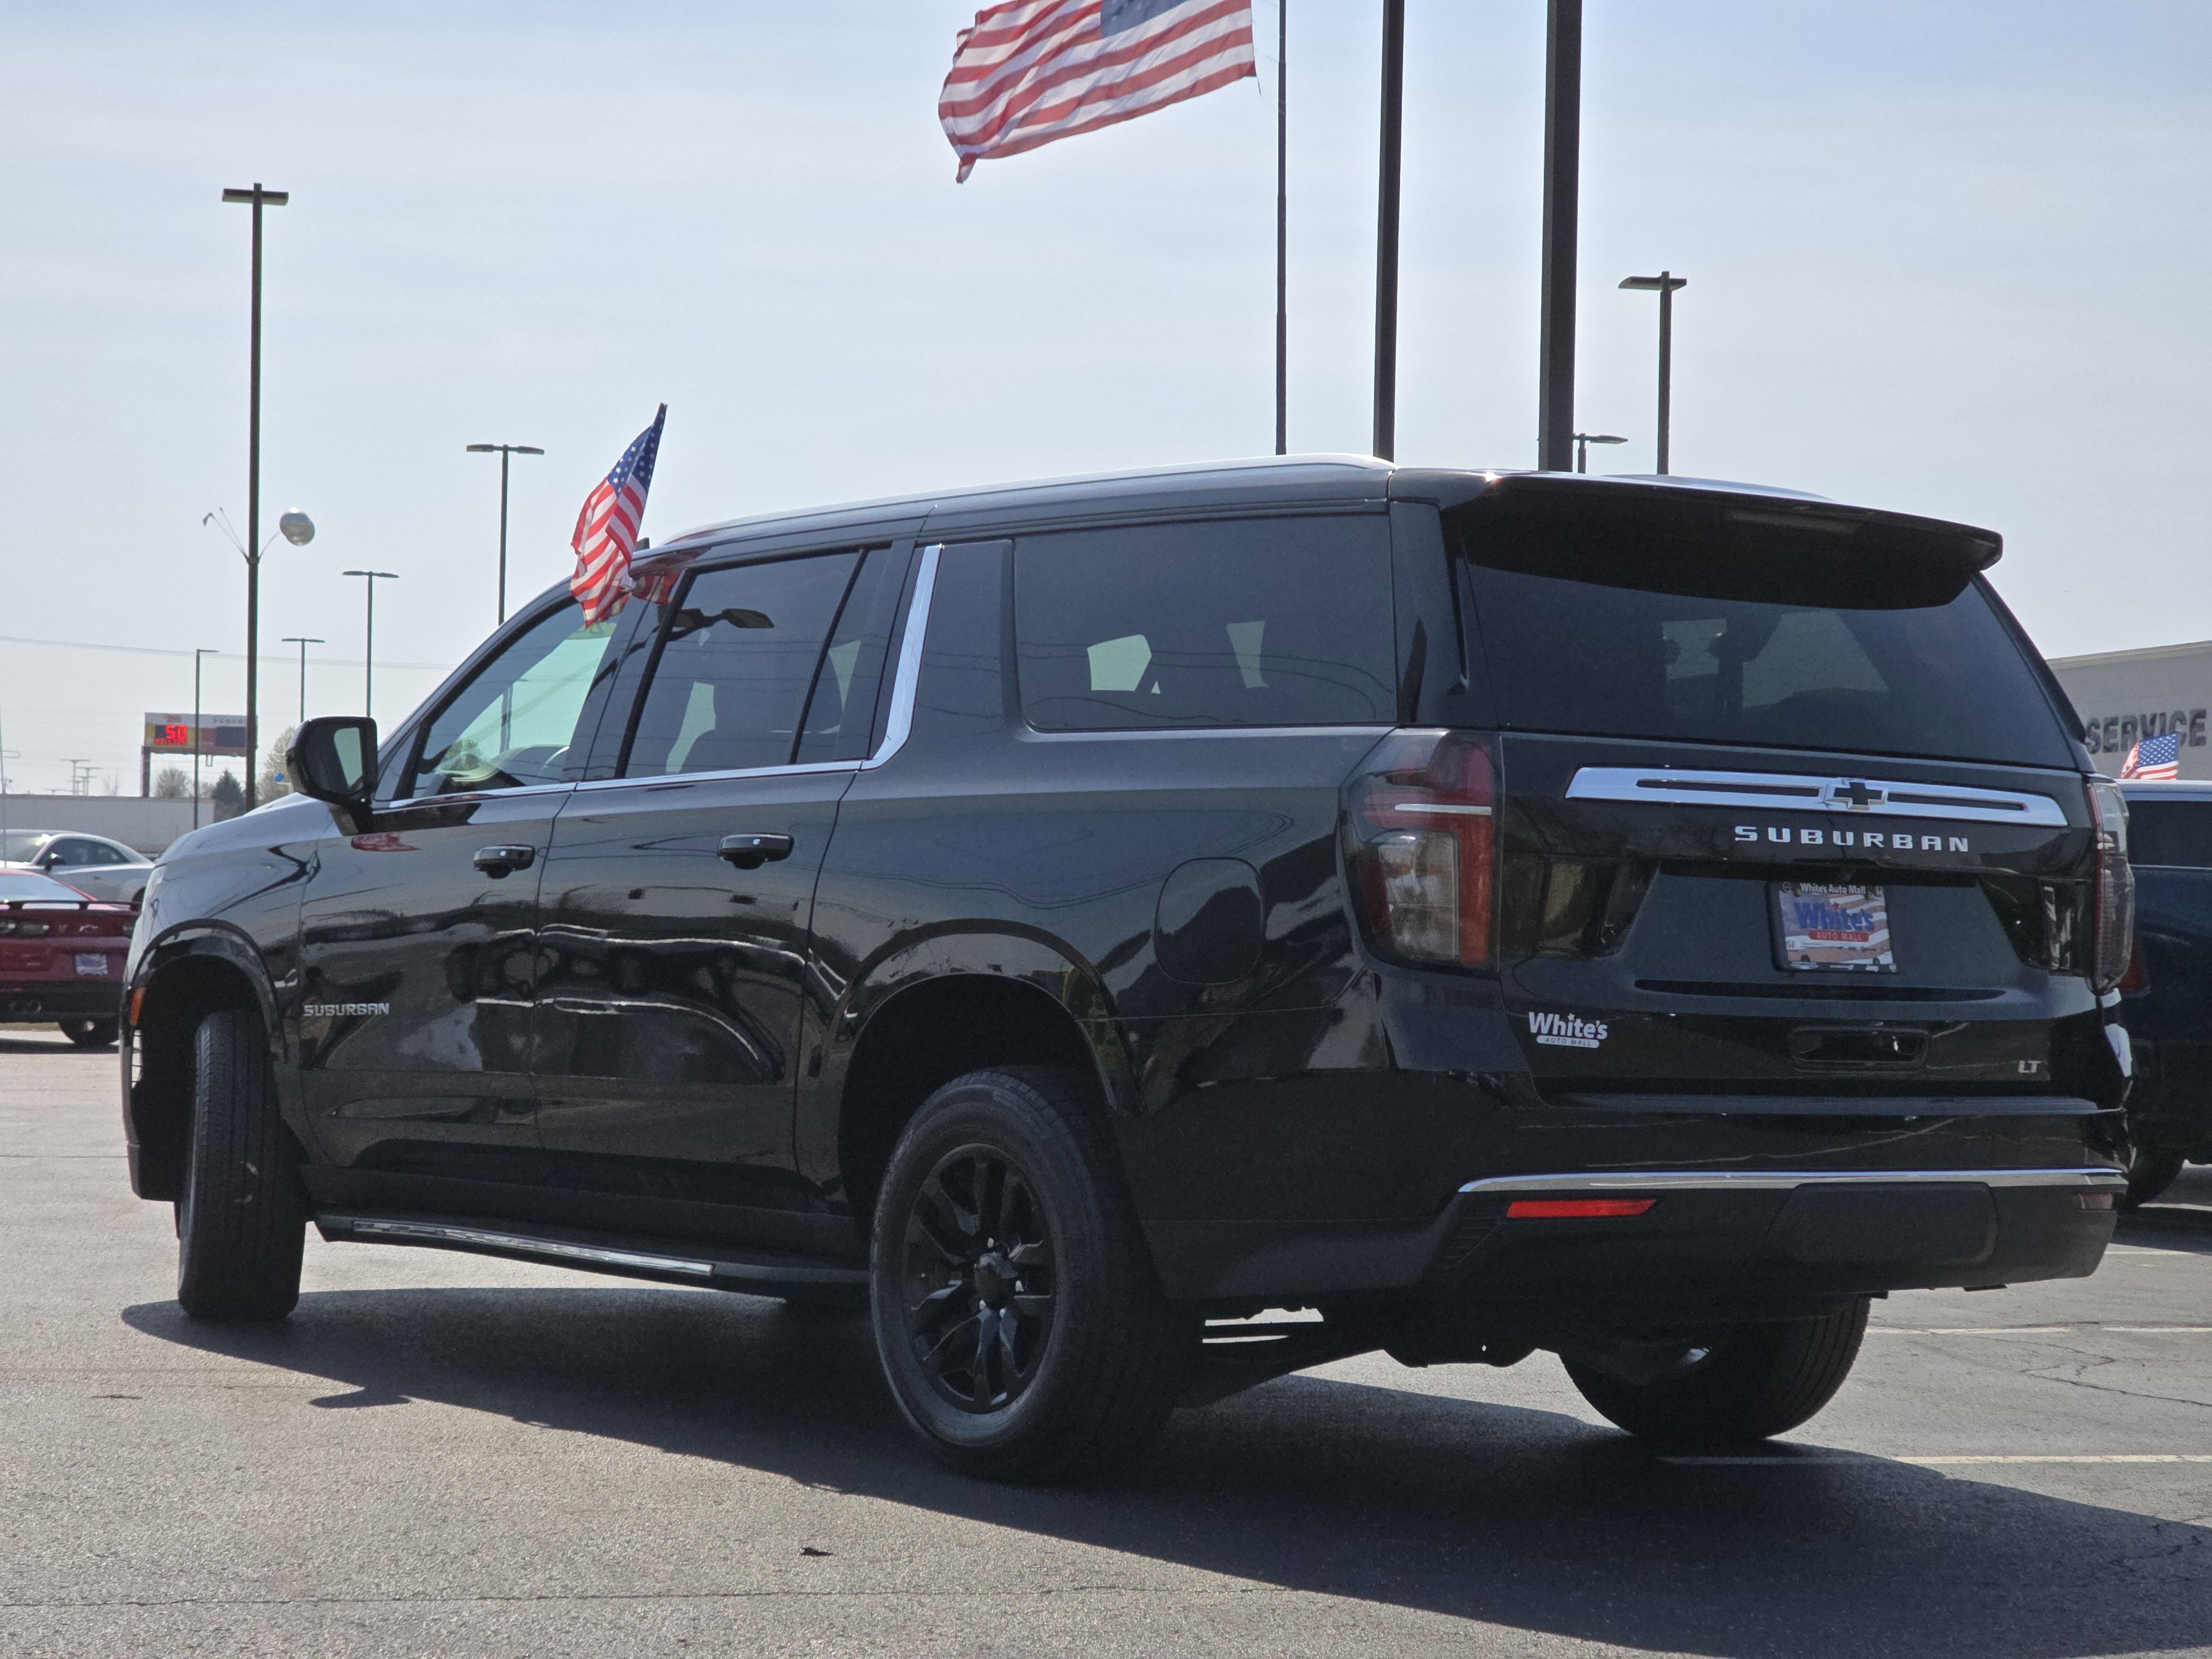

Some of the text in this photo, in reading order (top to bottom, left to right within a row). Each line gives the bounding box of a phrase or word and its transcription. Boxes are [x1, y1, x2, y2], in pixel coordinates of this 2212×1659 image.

[165, 724, 187, 739] 50
[2085, 709, 2206, 754] SERVICE
[1734, 826, 1969, 852] SUBURBAN
[1828, 884, 1847, 894] Auto
[1848, 885, 1866, 894] Mall
[1793, 901, 1875, 931] White's
[1816, 931, 1863, 941] AUTO MALL
[304, 1003, 390, 1017] SUBURBAN
[1528, 1011, 1608, 1040] White's
[2018, 1060, 2041, 1073] LT
